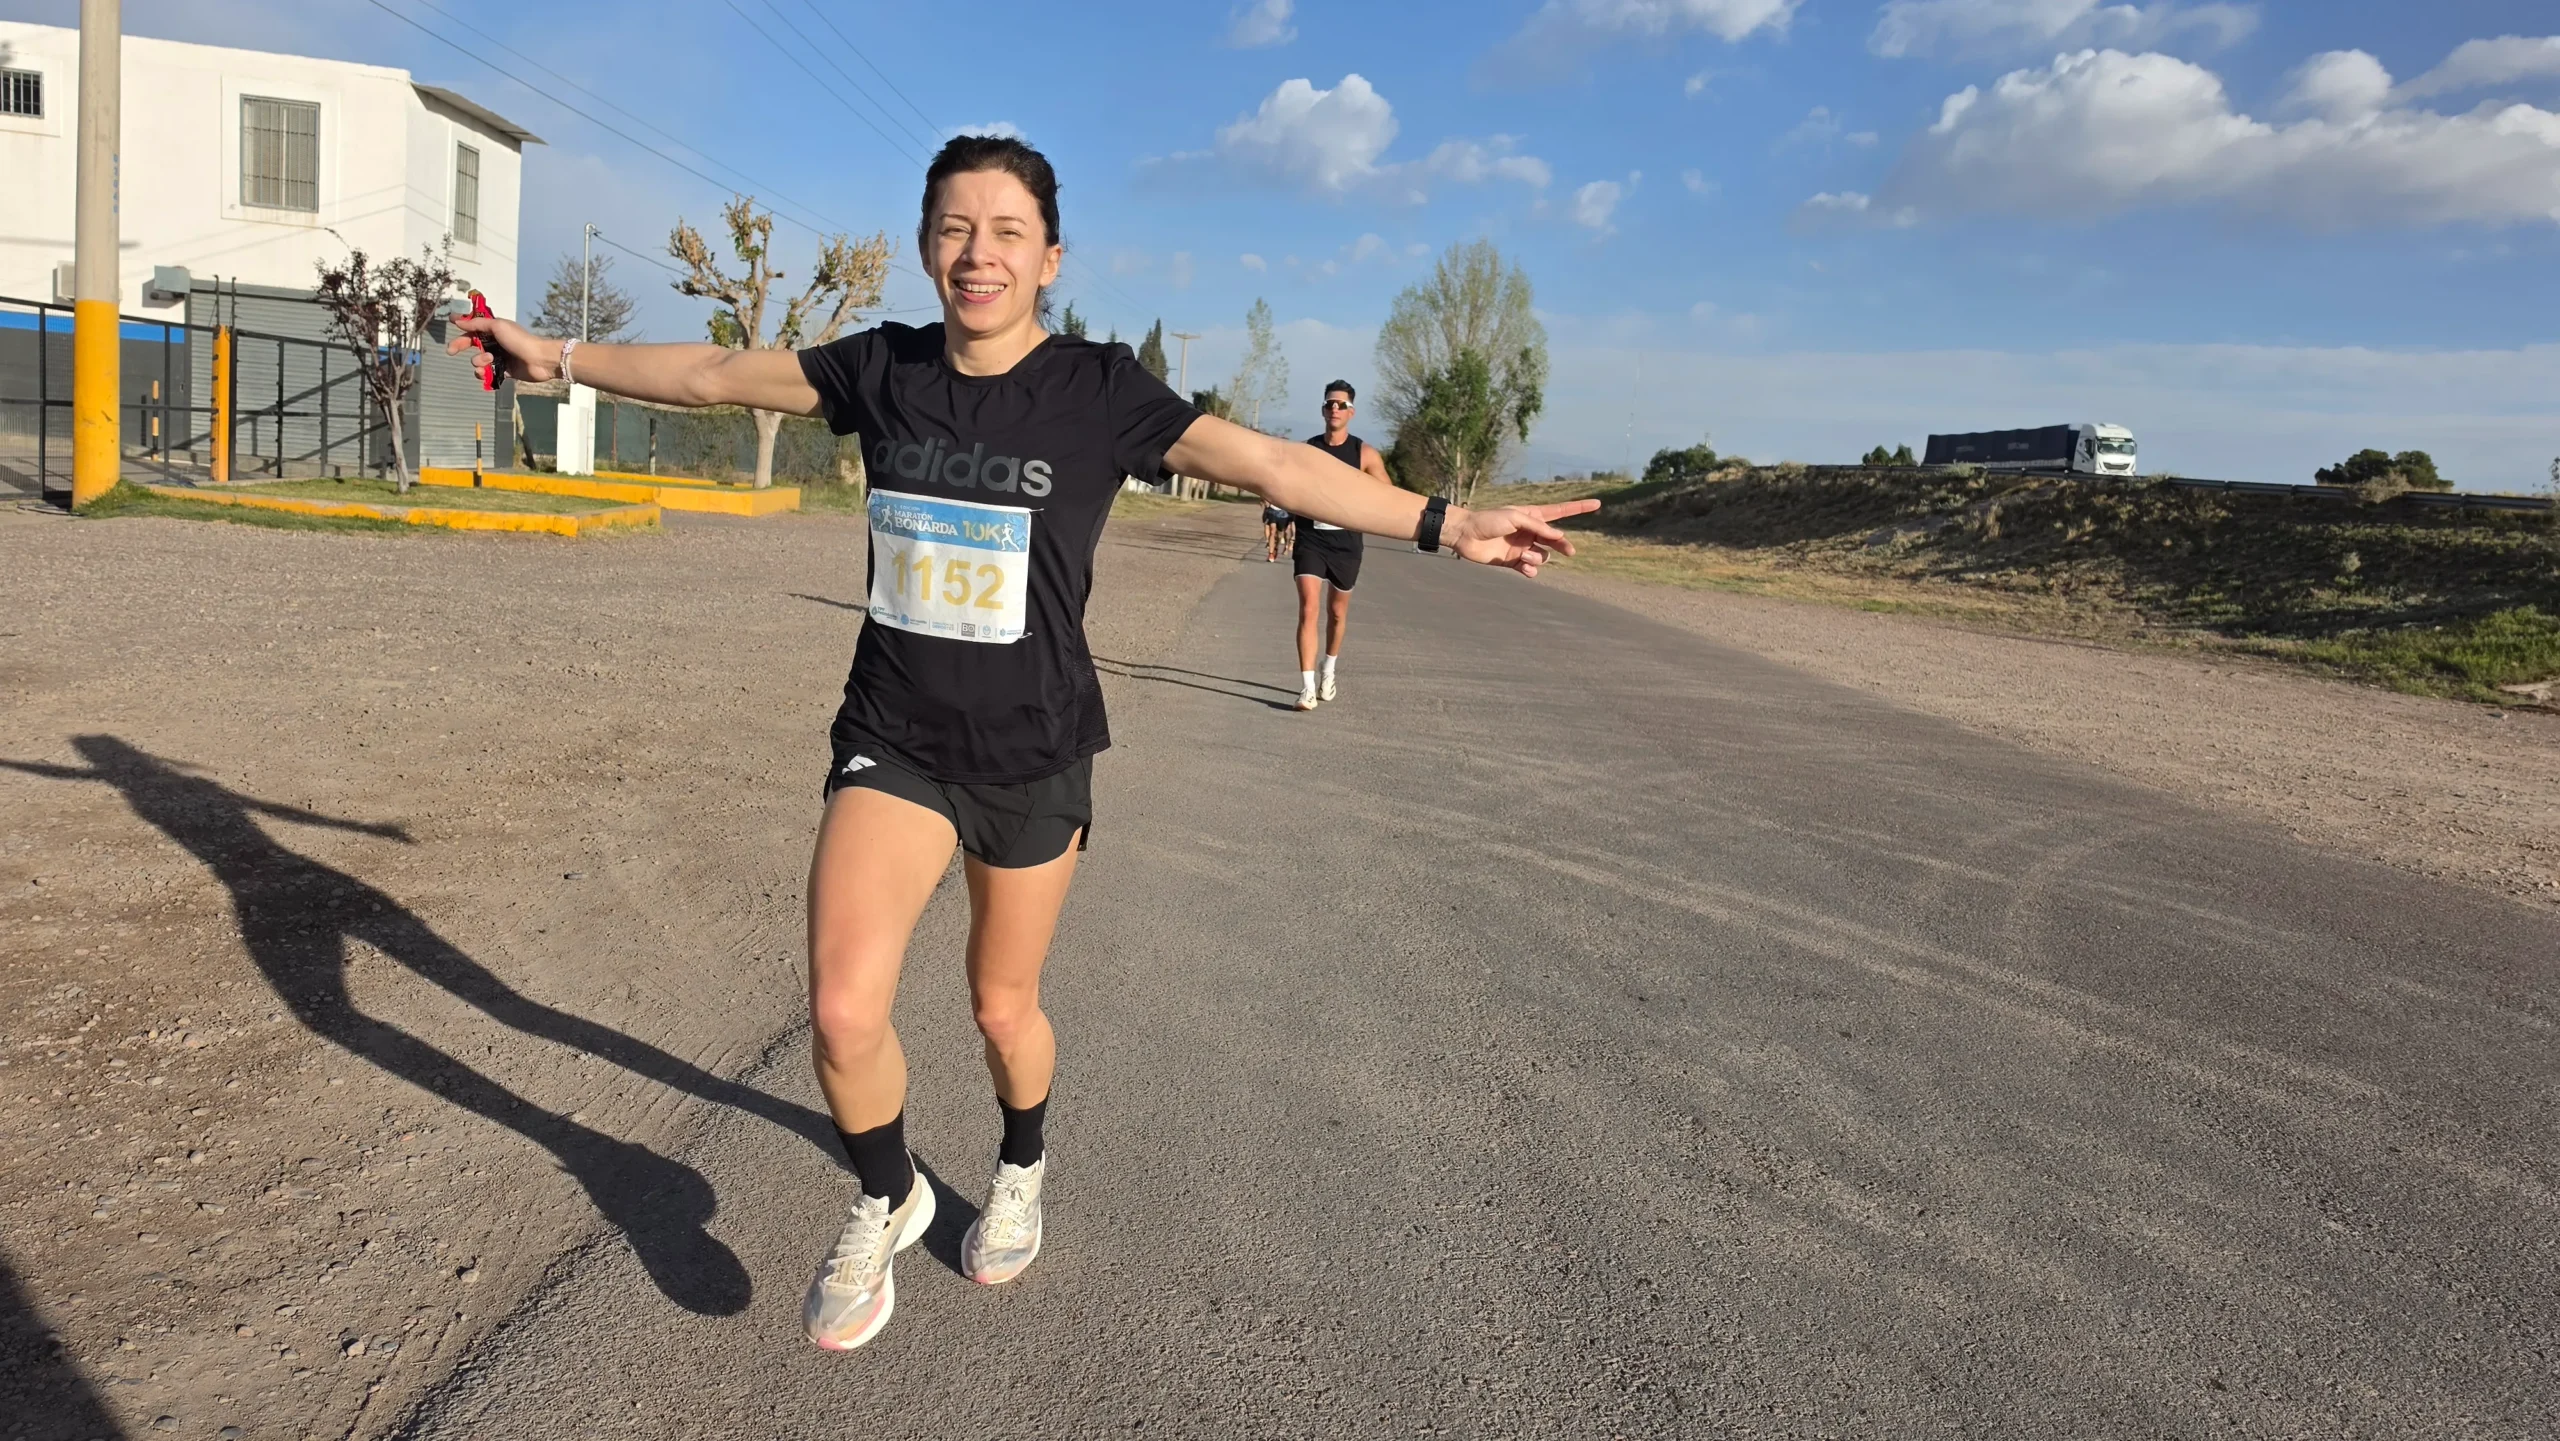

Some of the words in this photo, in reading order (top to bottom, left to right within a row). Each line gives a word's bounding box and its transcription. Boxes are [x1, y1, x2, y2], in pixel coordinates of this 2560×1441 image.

[871, 436, 1053, 498] adidas
[894, 510, 934, 521] MARATÓN
[894, 517, 958, 536] BONARDA
[962, 520, 1001, 544] 10K
[892, 551, 1004, 610] 1152
